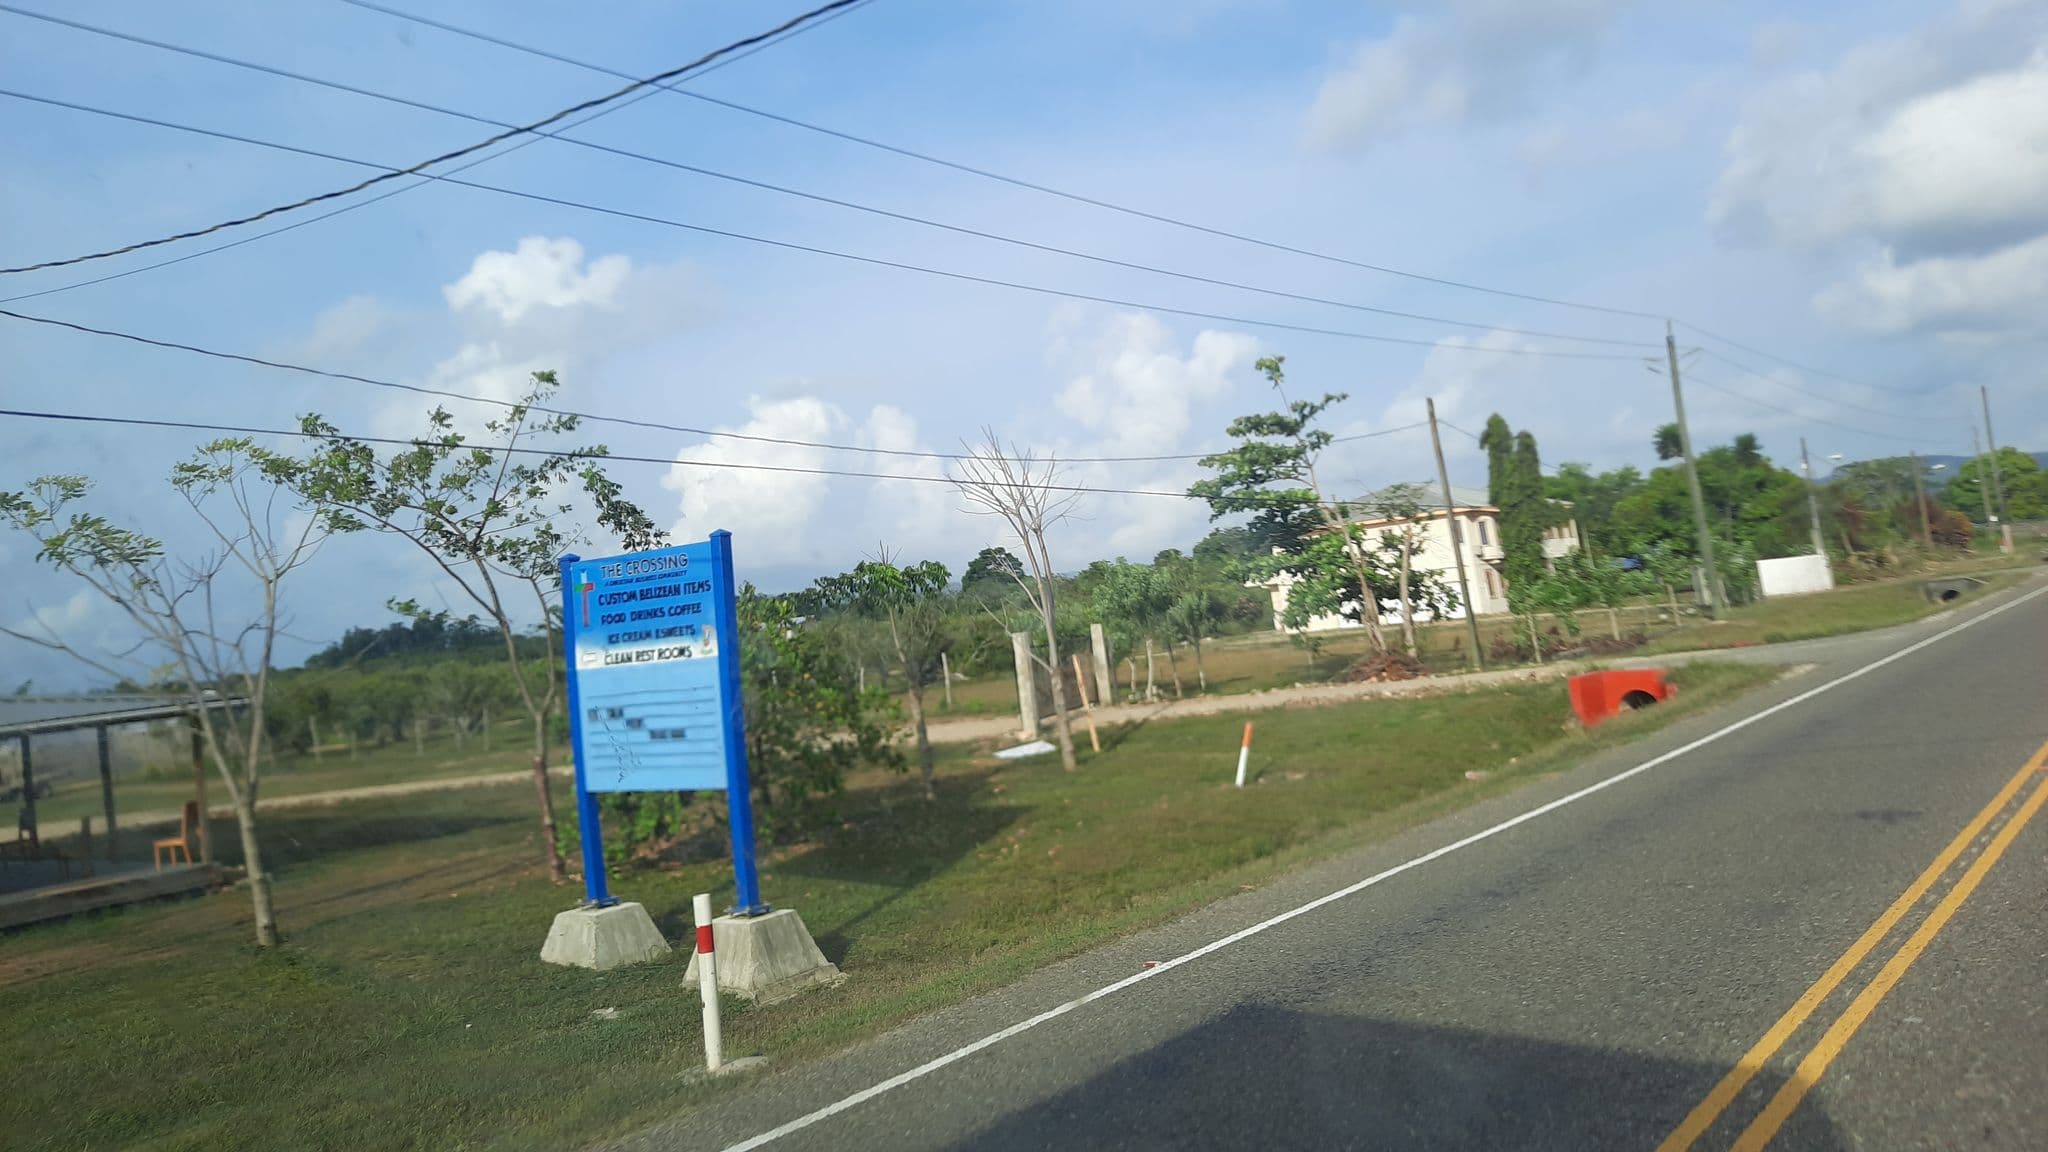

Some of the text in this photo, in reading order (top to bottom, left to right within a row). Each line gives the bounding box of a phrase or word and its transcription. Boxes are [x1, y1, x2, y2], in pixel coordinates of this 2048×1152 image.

[601, 554, 688, 578] THE CROSSING
[598, 580, 711, 606] CUSTOM BELIZEAN ITEMS
[601, 602, 702, 625] FOOD DRINKS COFFEE
[608, 633, 619, 644] ICE
[622, 630, 651, 642] CREAM
[605, 646, 692, 665] CLEAN REST ROOMS
